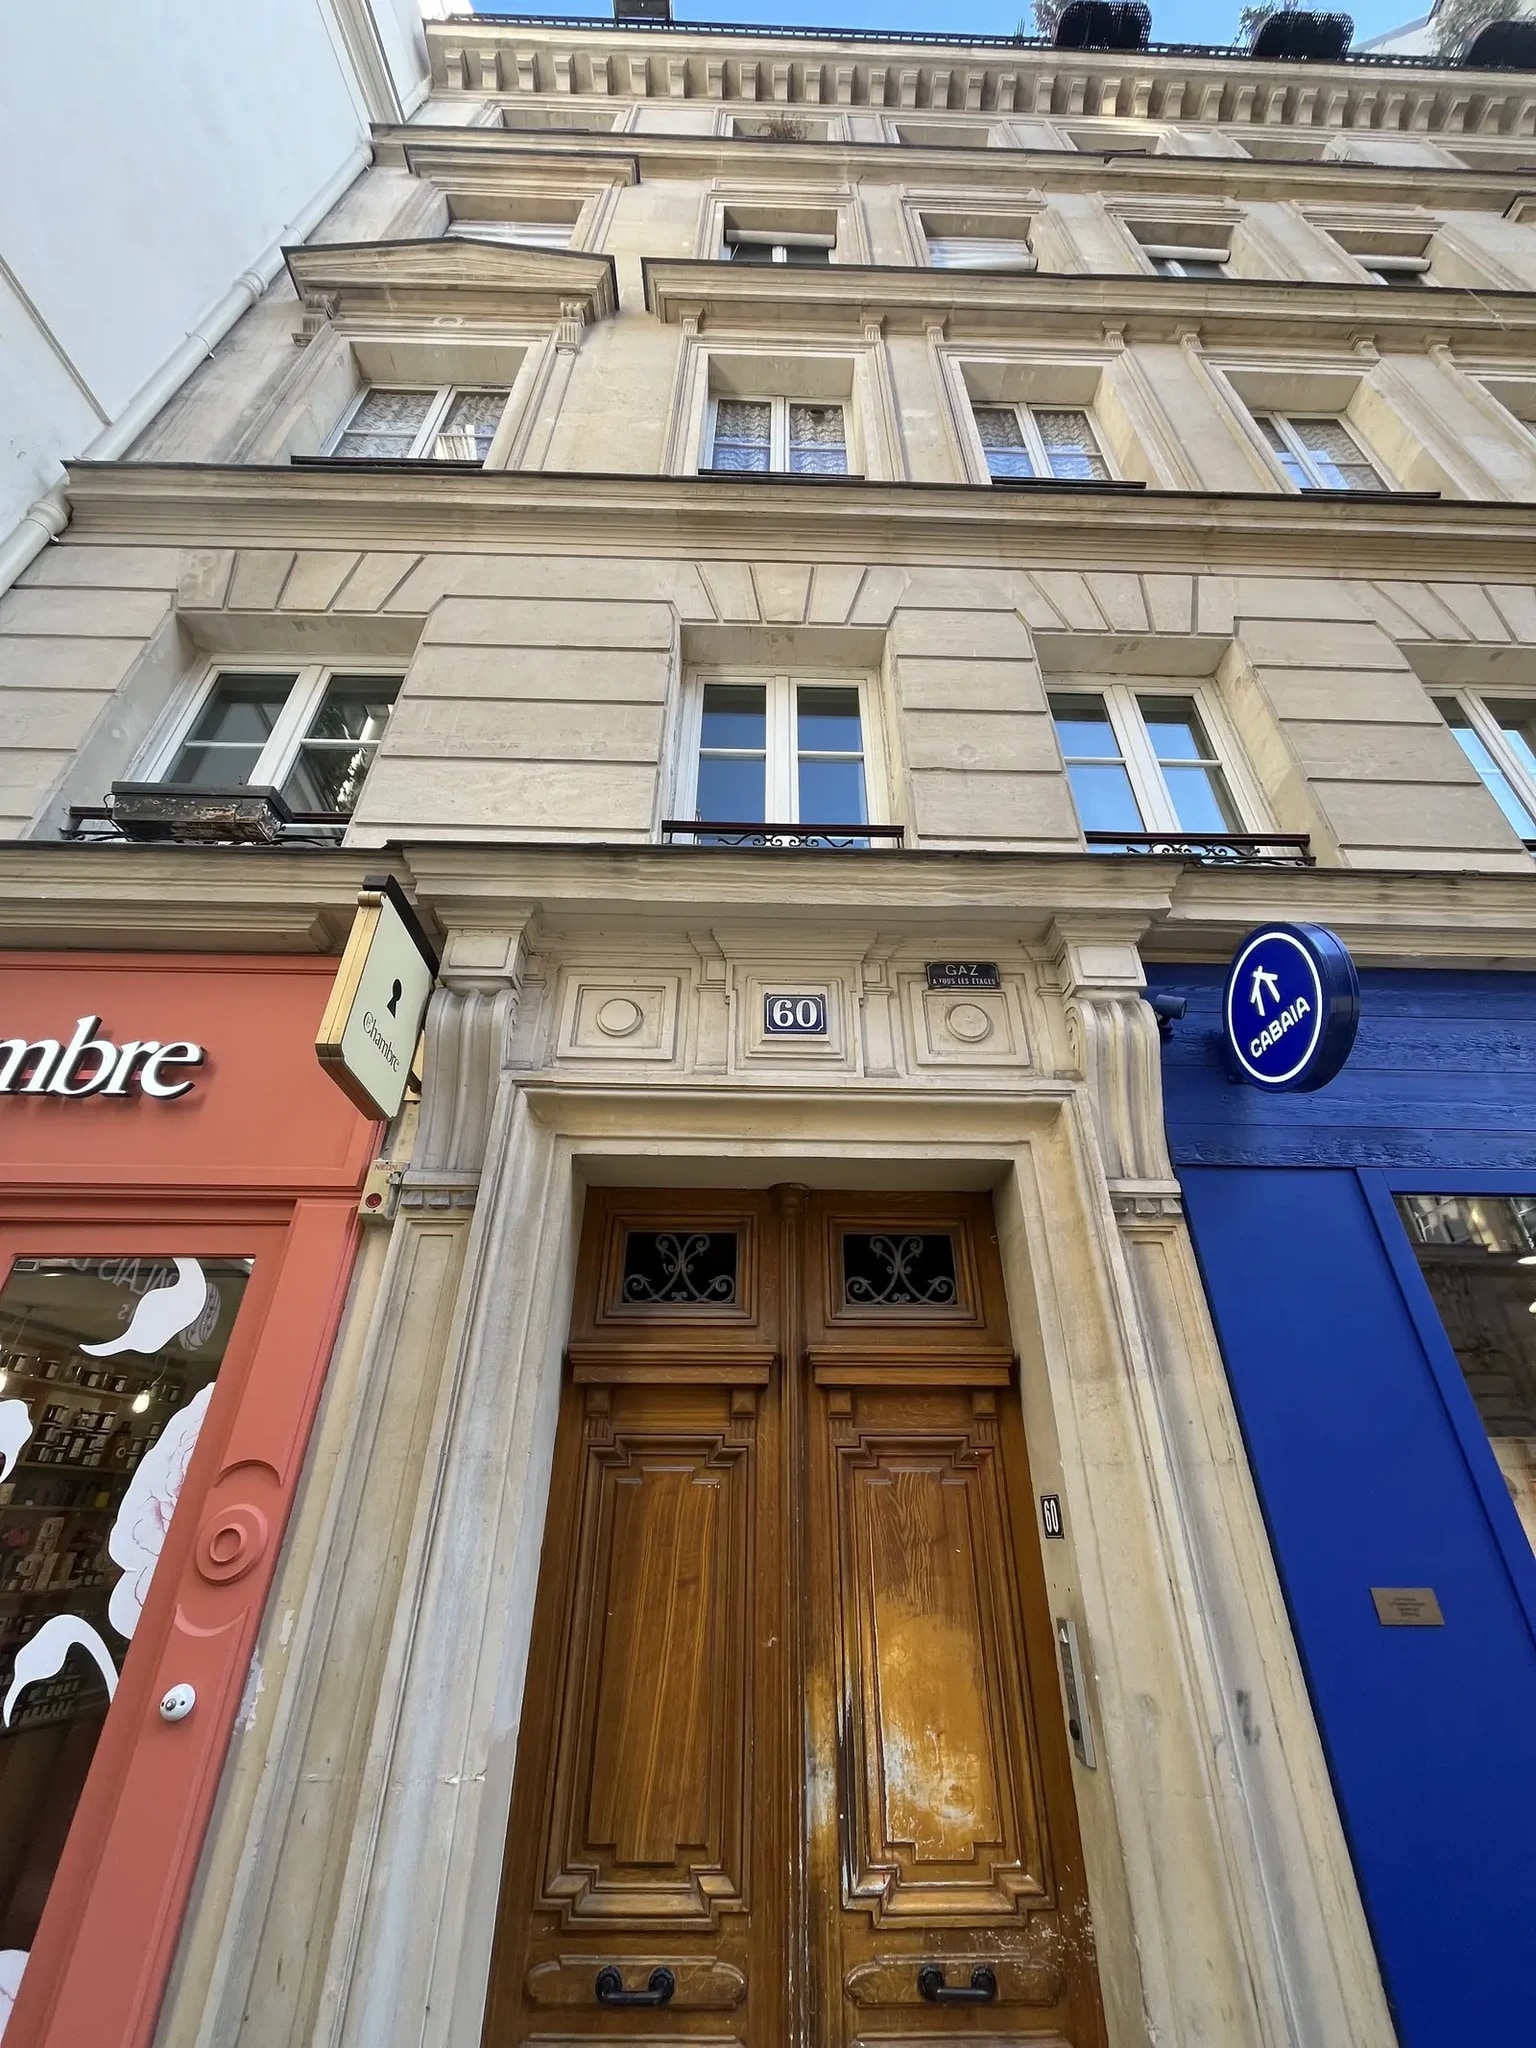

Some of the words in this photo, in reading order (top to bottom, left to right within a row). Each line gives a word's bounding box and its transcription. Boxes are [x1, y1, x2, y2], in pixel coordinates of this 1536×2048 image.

[945, 964, 979, 976] GAZ
[957, 977, 971, 985] LES
[772, 999, 819, 1029] 60
[1249, 996, 1311, 1058] CABAIA
[363, 1011, 400, 1073] Chambre
[1043, 1499, 1059, 1533] 60
